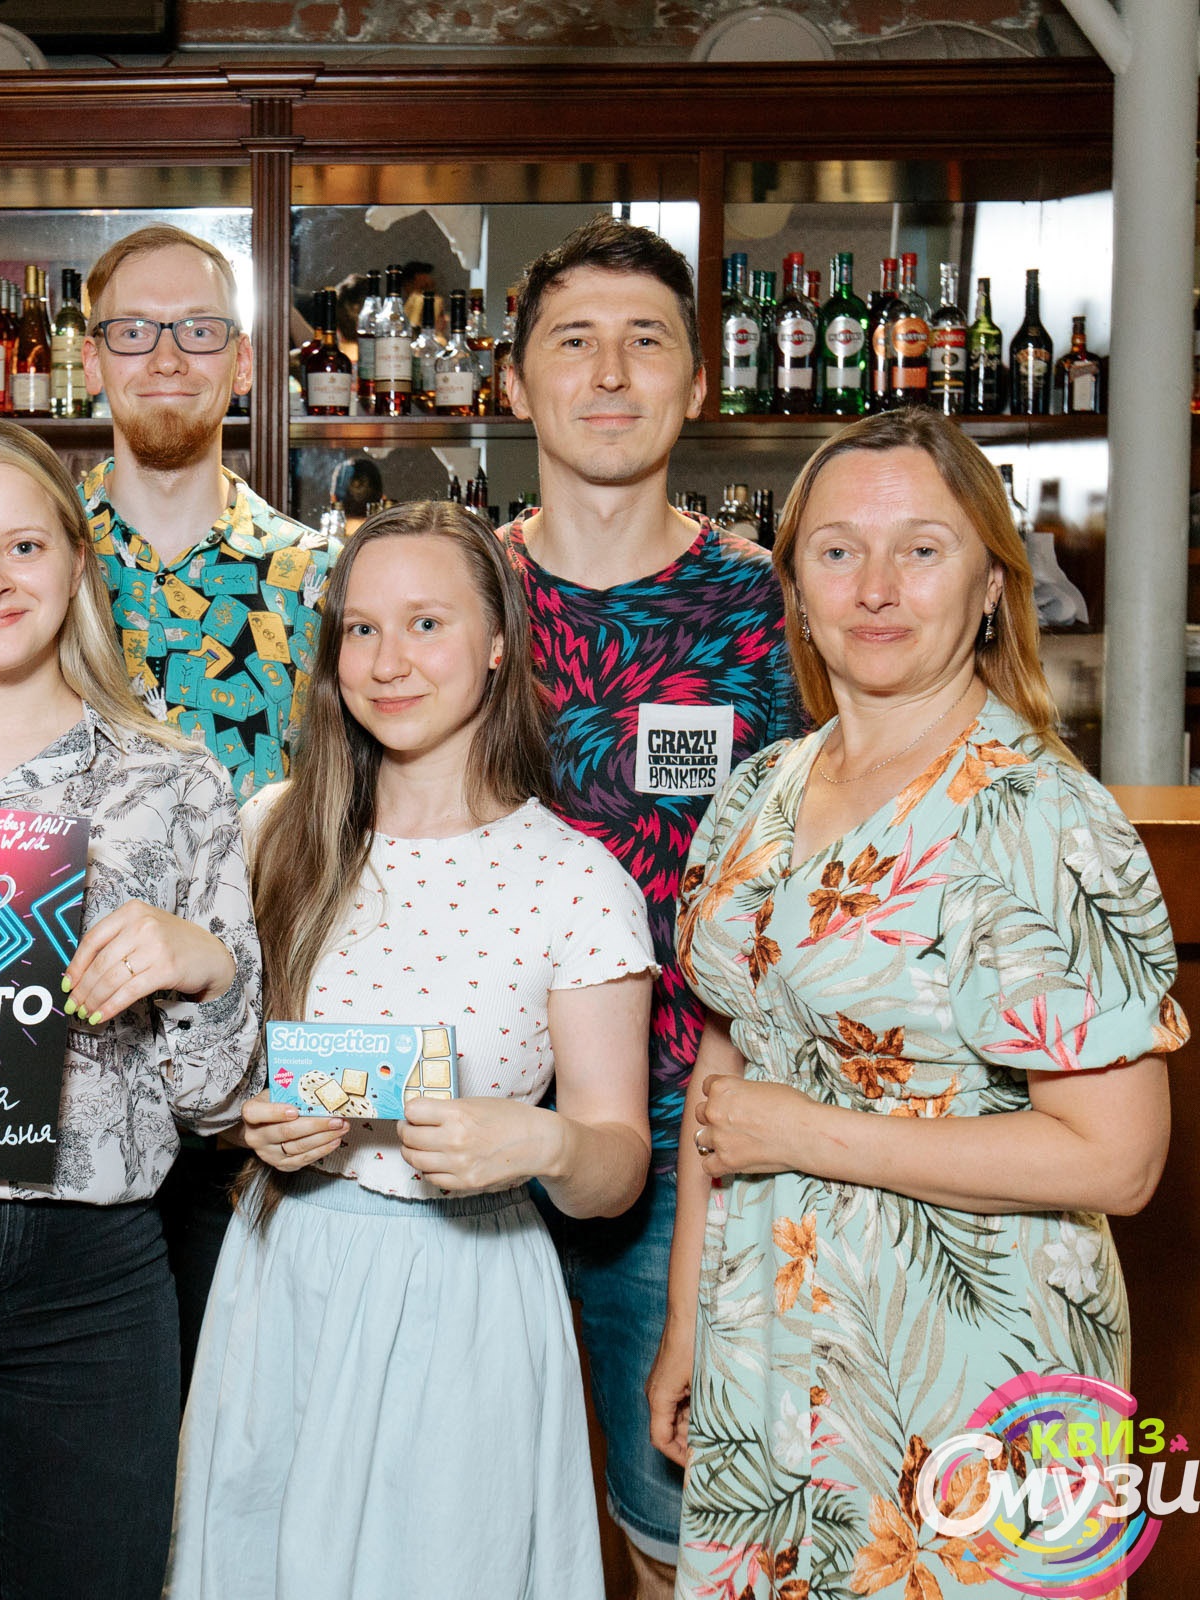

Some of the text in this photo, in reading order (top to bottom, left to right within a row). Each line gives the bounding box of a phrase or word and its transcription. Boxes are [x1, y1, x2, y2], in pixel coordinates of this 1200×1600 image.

[648, 729, 717, 755] CRAZY
[649, 755, 717, 765] LUNATIC
[648, 766, 717, 789] BONKERS
[271, 1026, 391, 1058] Schogetten
